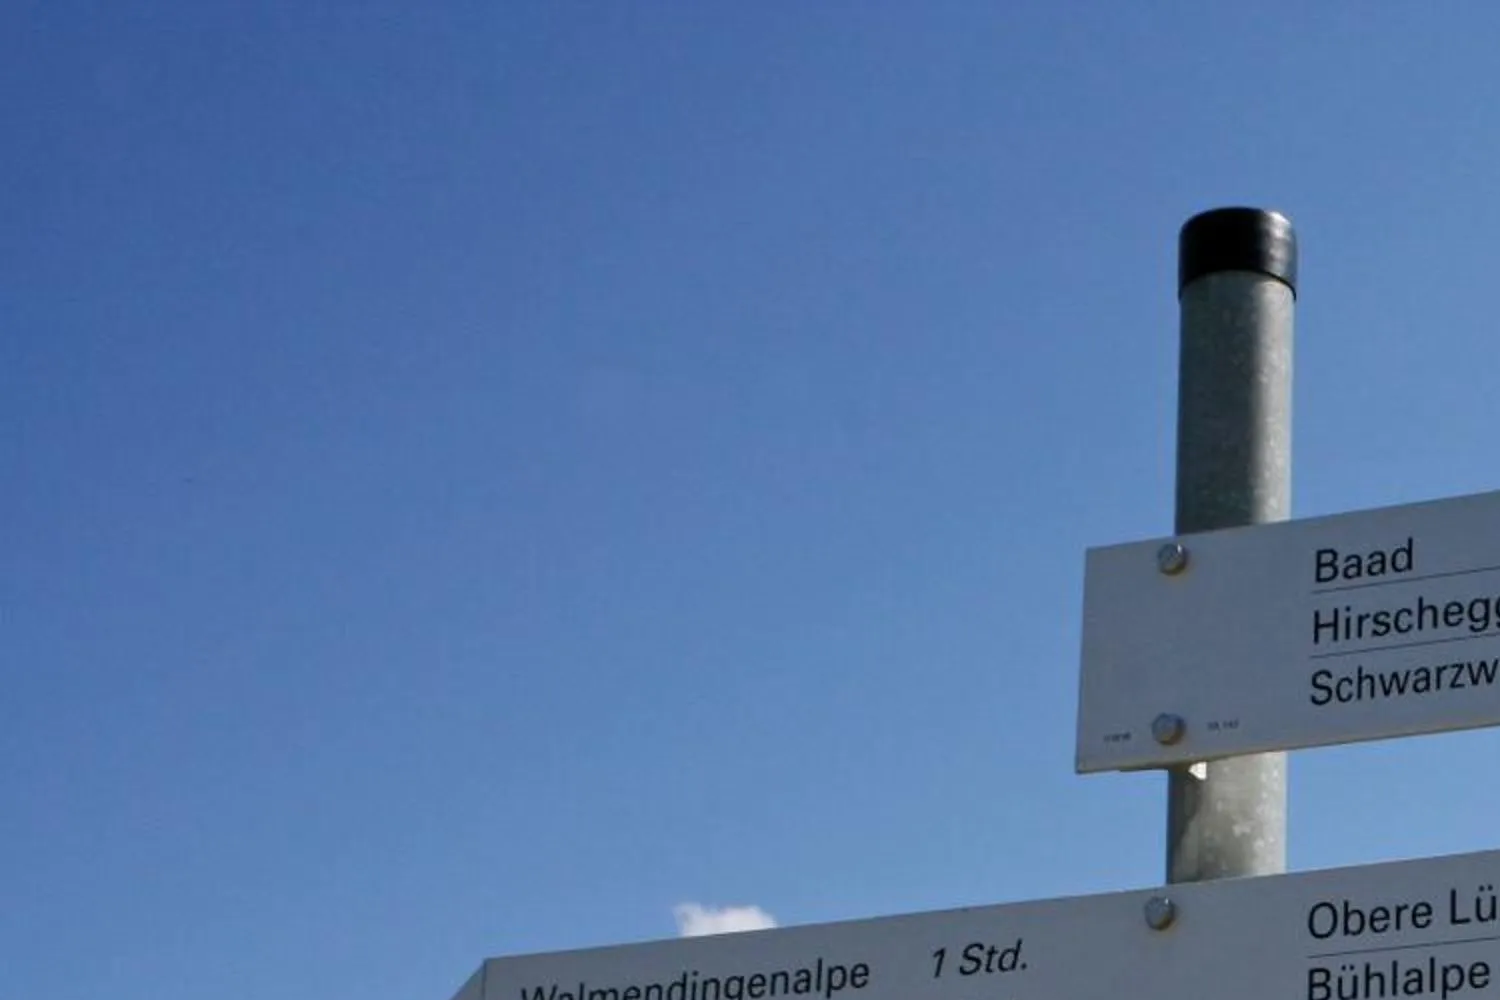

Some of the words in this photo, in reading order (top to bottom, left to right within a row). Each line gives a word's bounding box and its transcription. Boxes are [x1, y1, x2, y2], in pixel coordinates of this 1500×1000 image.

[1315, 537, 1413, 584] Baad
[1307, 900, 1432, 940] Obere
[959, 938, 1027, 976] Std.
